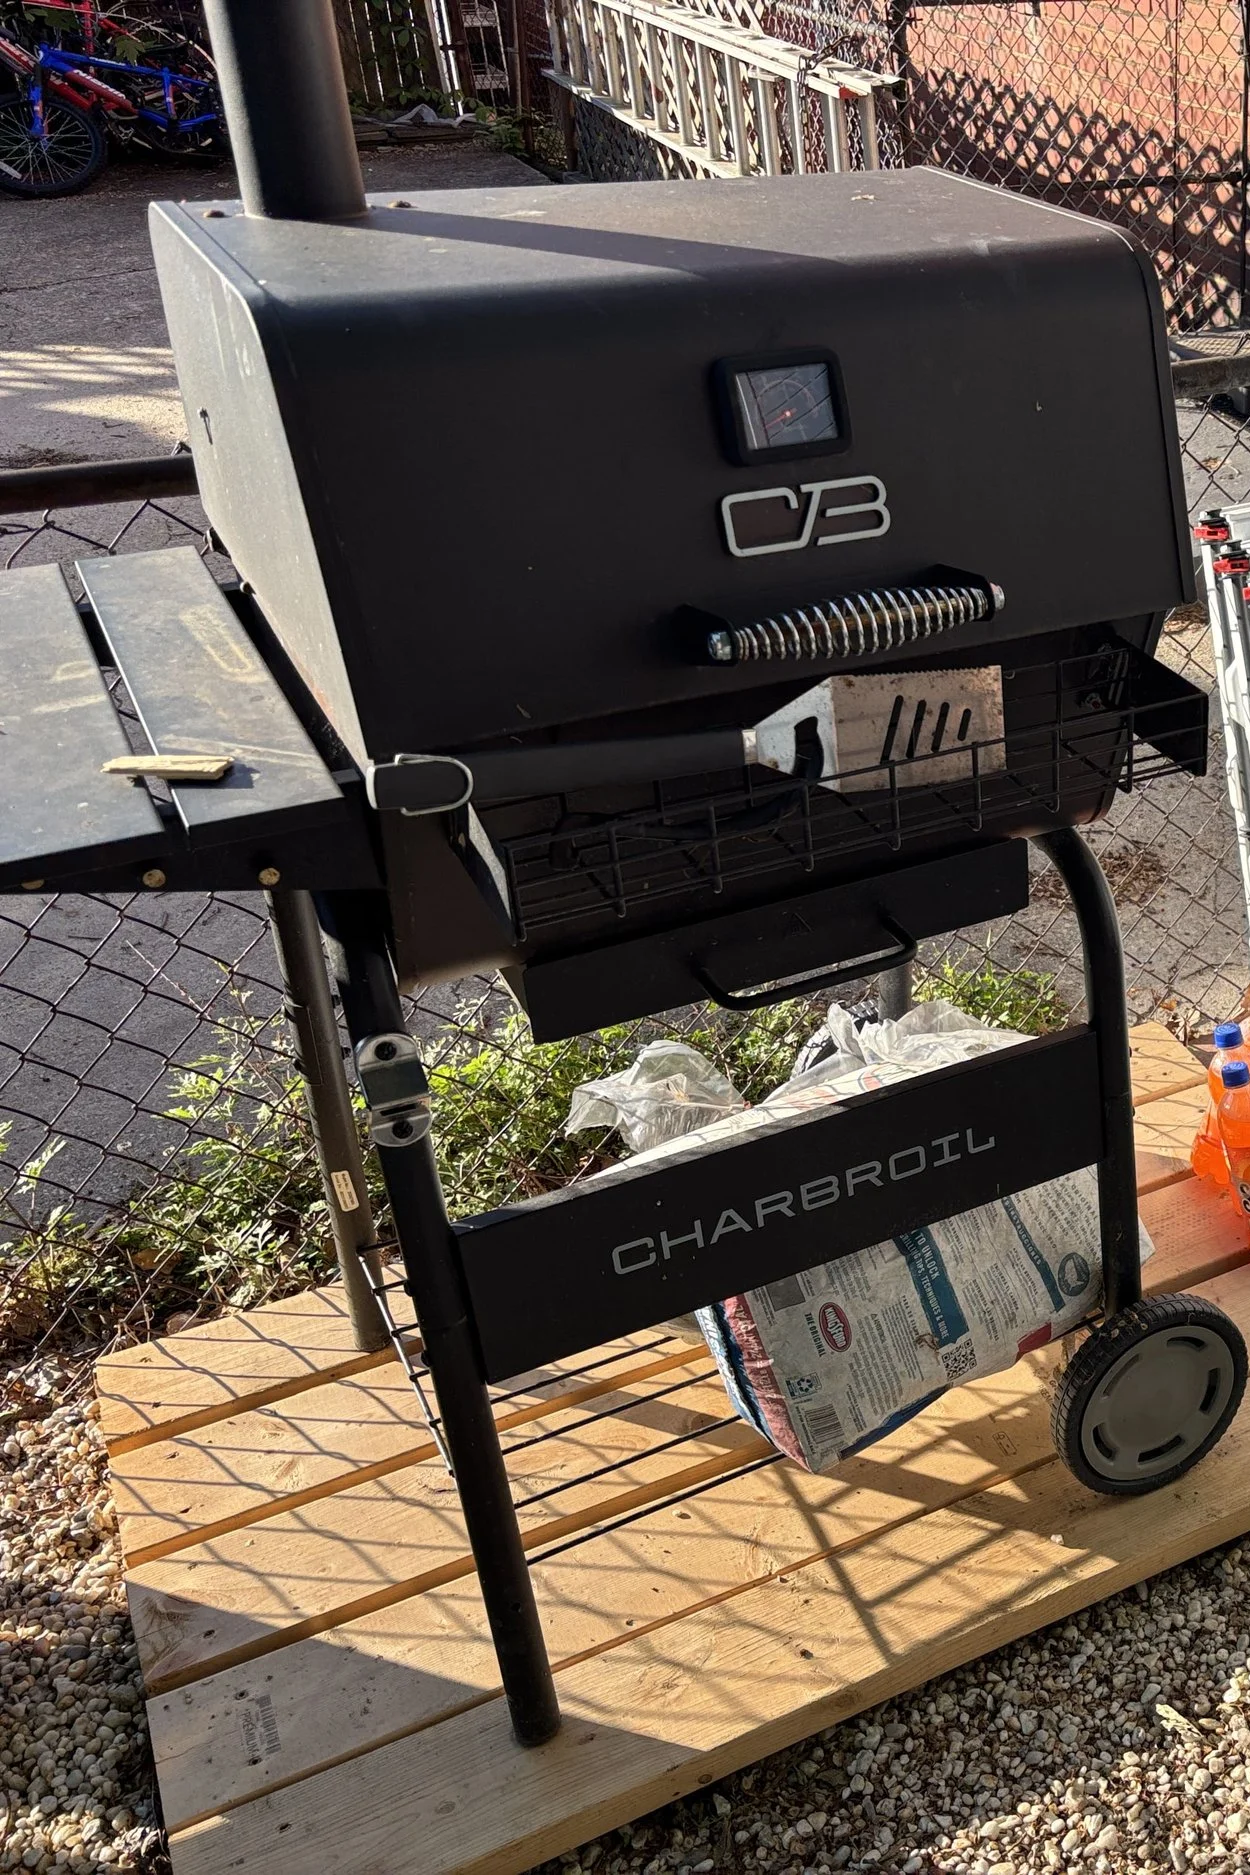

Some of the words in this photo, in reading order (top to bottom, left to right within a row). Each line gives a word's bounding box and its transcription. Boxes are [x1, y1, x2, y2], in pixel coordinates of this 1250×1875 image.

[610, 1126, 997, 1276] CHARBROIL
[913, 1232, 927, 1247] TO
[919, 1245, 940, 1279] UNLOCK
[822, 1306, 848, 1347] KINGSFORD
[919, 1275, 941, 1315] TECHNIQUES
[936, 1320, 950, 1339] MORE
[804, 1312, 814, 1326] THE
[809, 1325, 825, 1357] ORIGINAL
[241, 1710, 259, 1755] PREMIUM
